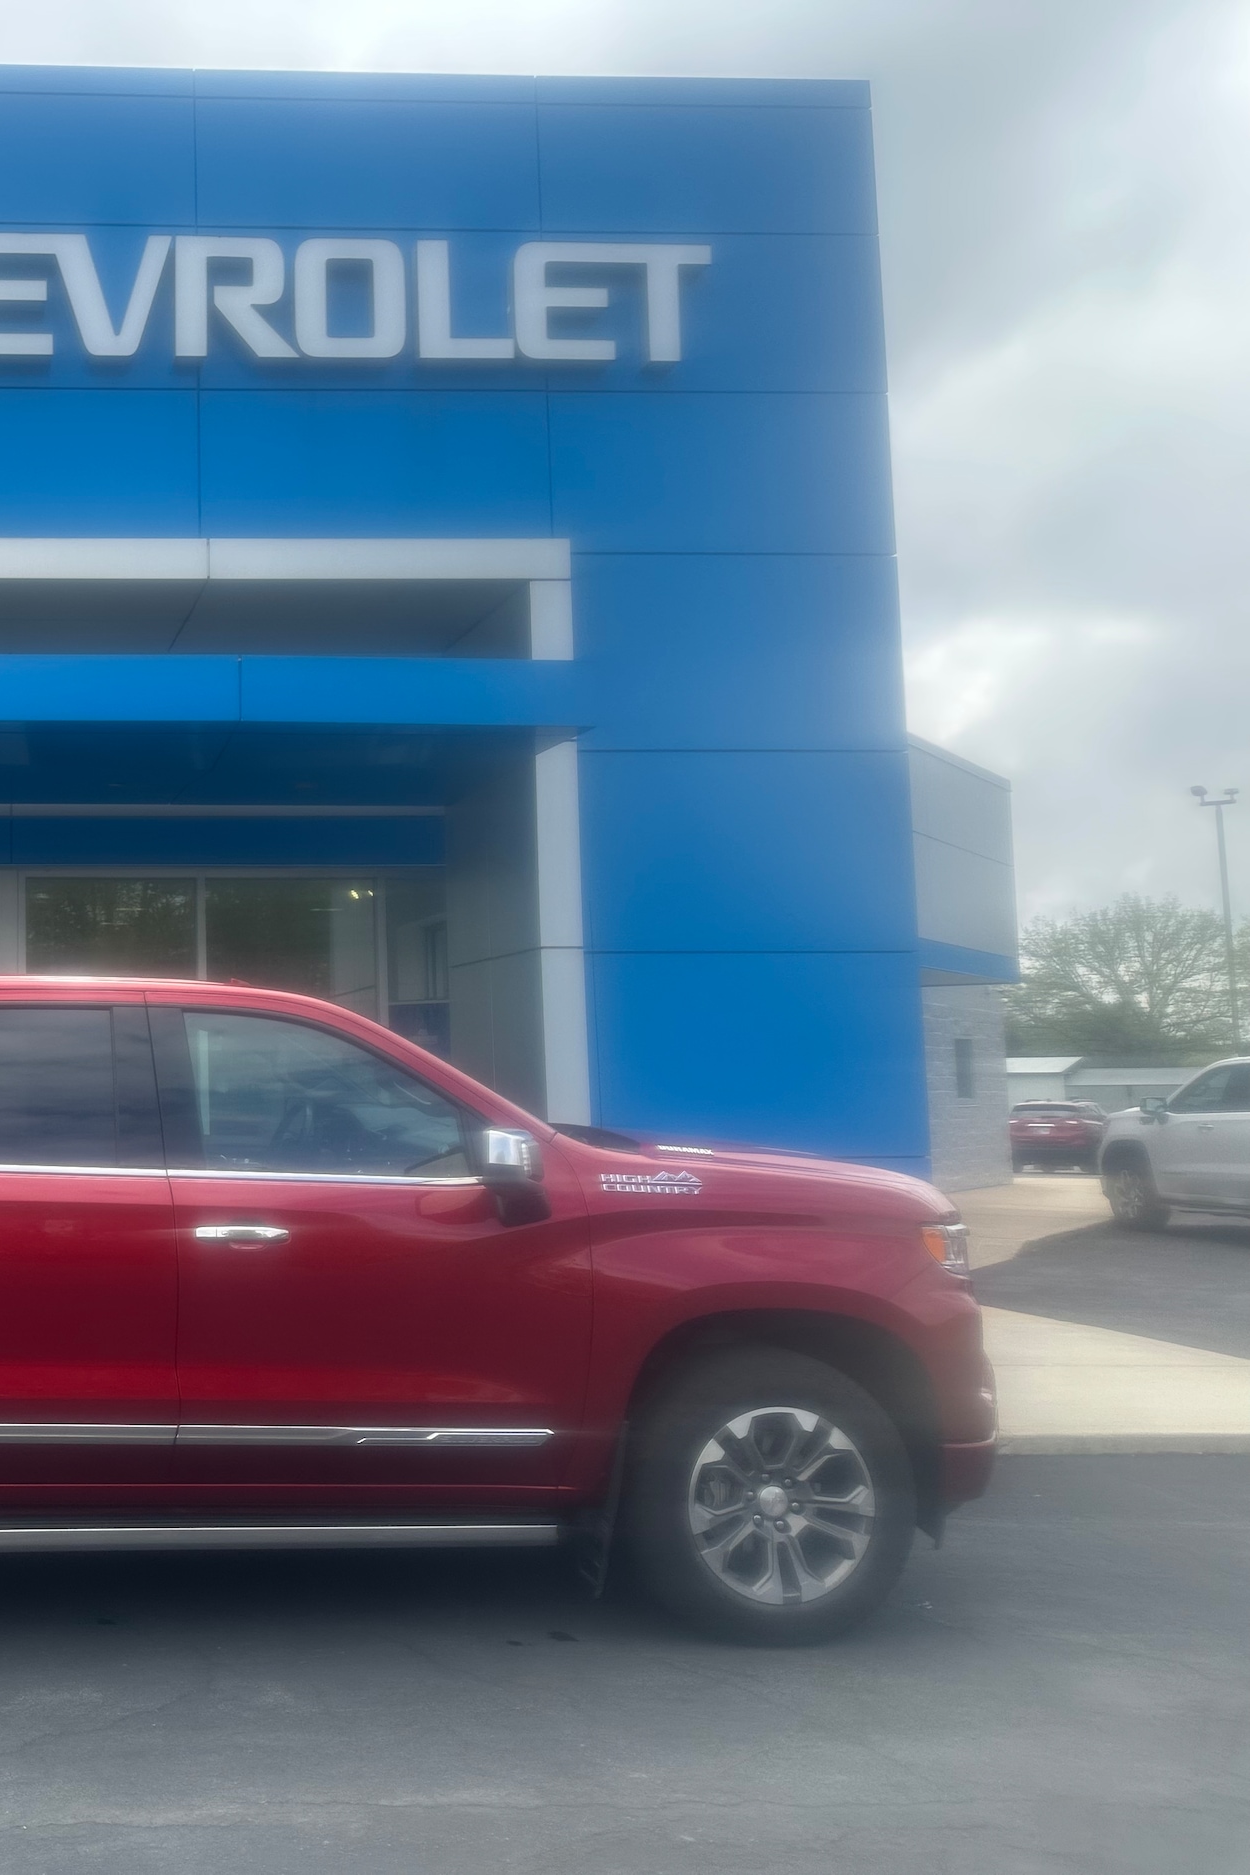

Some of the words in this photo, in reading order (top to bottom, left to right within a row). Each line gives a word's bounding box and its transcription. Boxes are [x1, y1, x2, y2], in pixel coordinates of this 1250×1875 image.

[655, 1144, 714, 1155] DURAMAX
[600, 1173, 651, 1183] HIGH
[601, 1183, 703, 1194] COUNTRY
